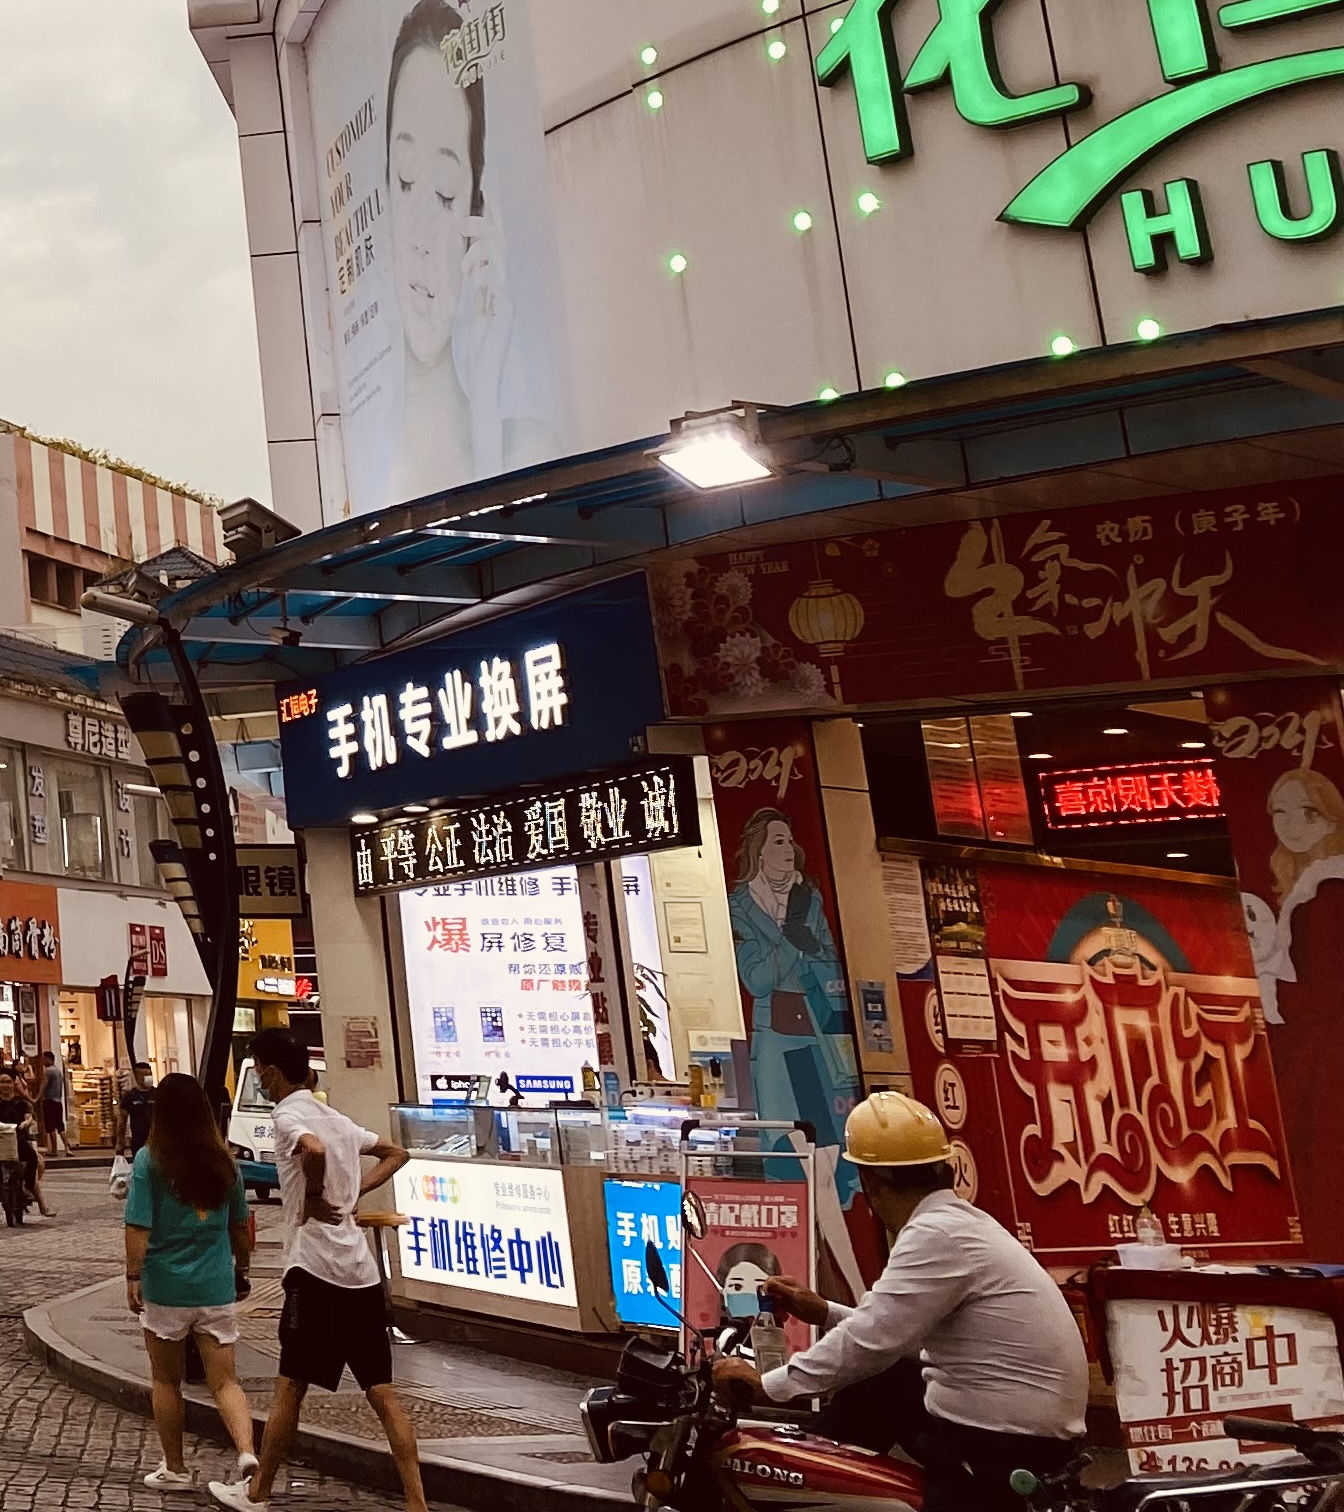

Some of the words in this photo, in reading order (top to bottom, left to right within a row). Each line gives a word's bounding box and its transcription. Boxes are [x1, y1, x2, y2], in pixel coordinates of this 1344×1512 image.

[279, 688, 319, 723] 汇恒电子
[326, 641, 569, 780] 手机专业换屏
[356, 838, 373, 886] 由
[380, 828, 417, 881] 平等
[425, 821, 465, 873] 公正
[470, 810, 514, 865] 法治
[524, 797, 569, 860] 爱国
[579, 786, 631, 849] 敬业
[151, 940, 166, 964] DS
[424, 916, 471, 954] 爆
[480, 931, 569, 954] 屏修复
[518, 1078, 572, 1091] SAMSUNG
[406, 1215, 566, 1289] 手机维修中心
[1158, 1302, 1240, 1353] 火爆
